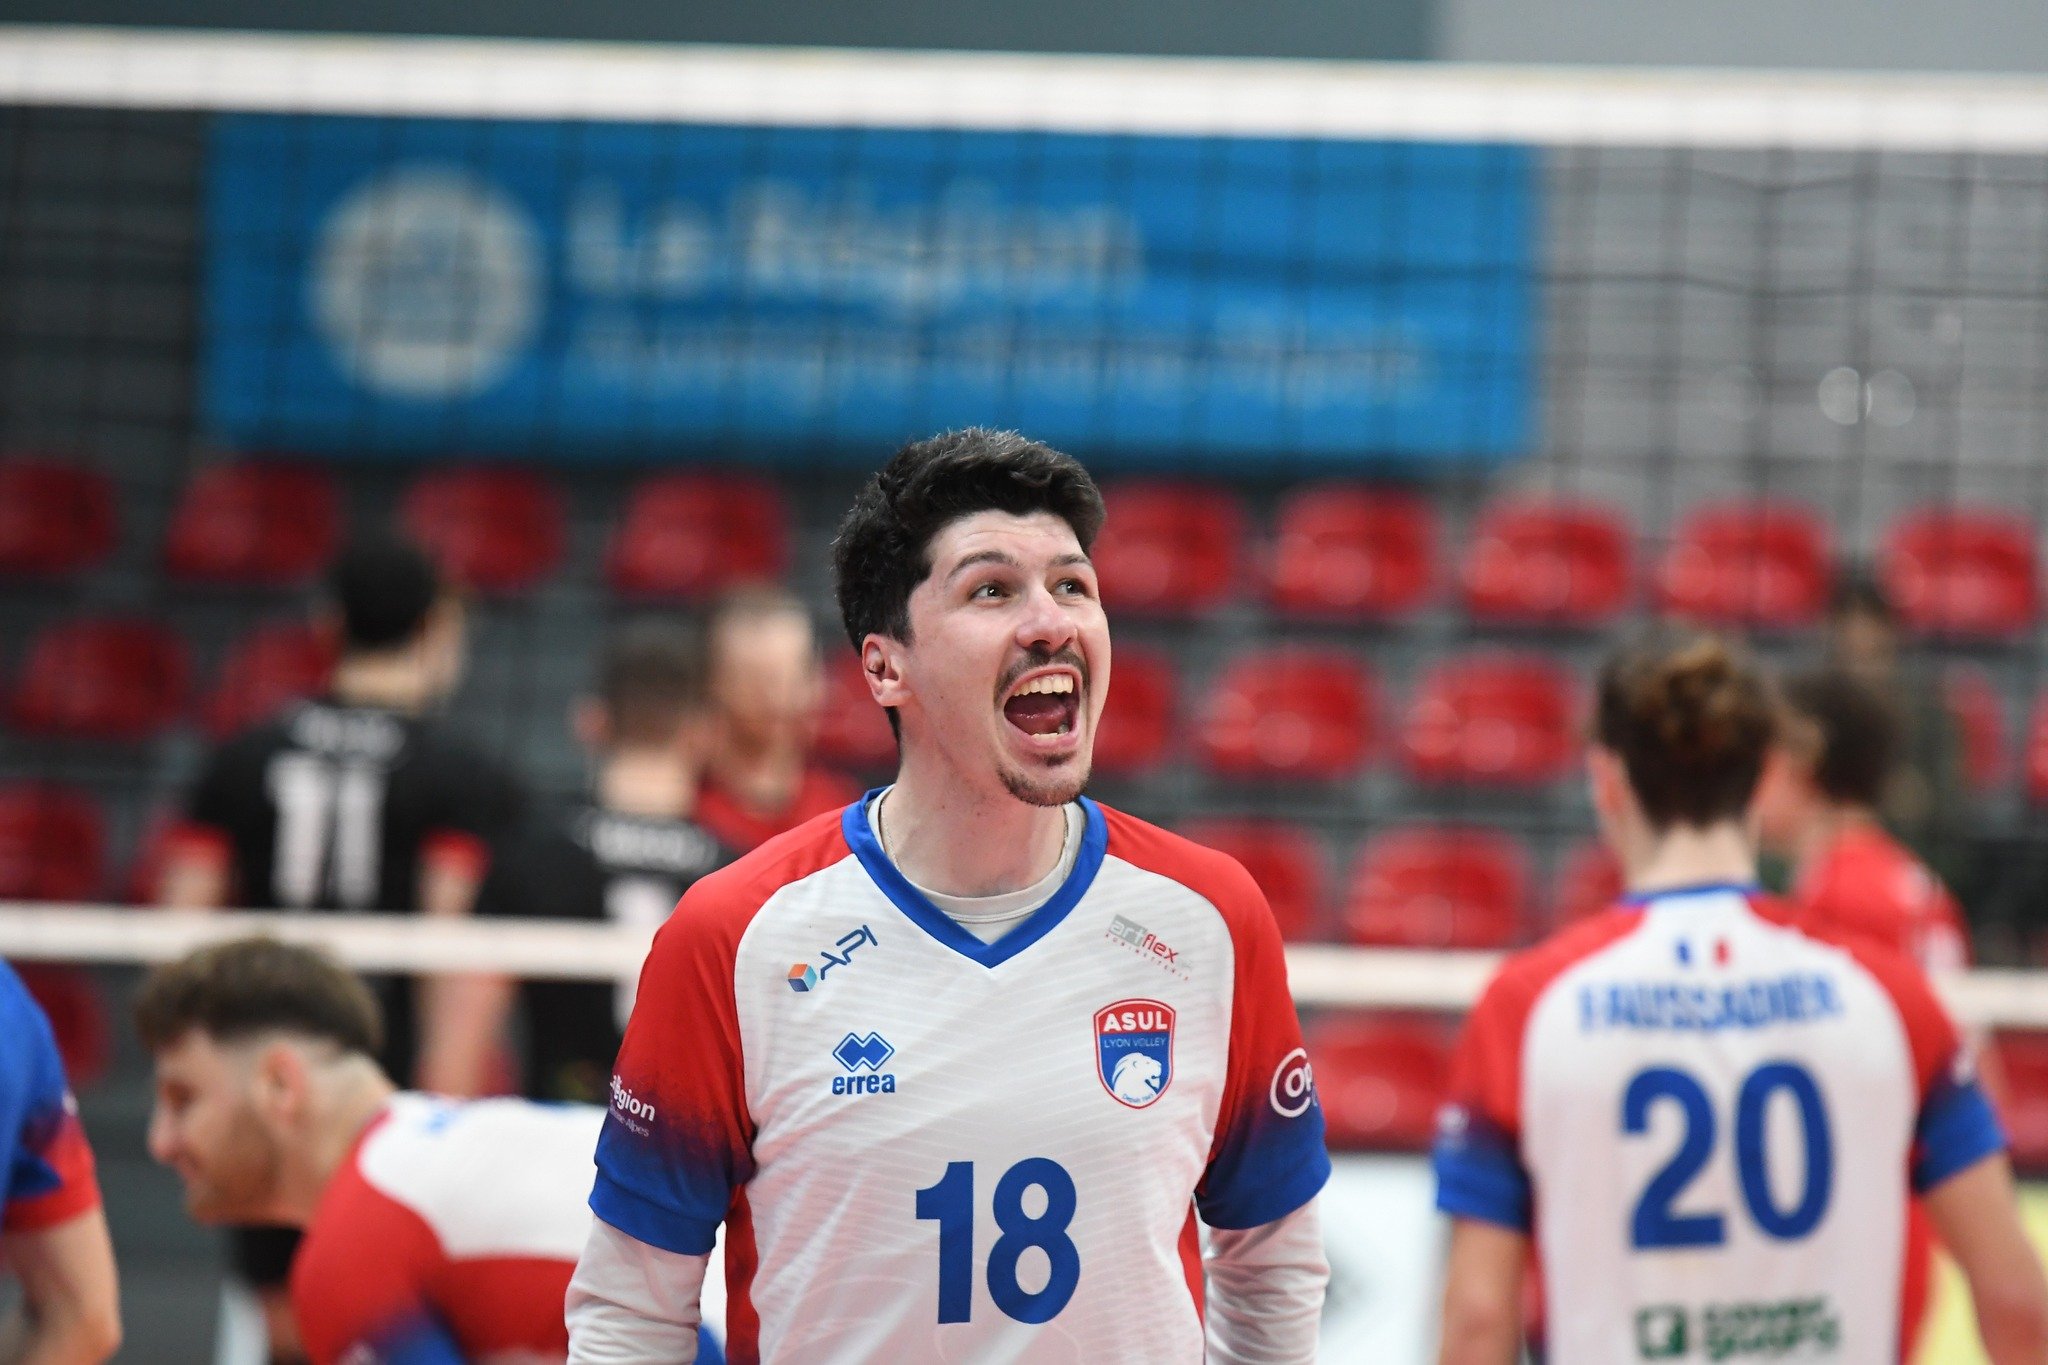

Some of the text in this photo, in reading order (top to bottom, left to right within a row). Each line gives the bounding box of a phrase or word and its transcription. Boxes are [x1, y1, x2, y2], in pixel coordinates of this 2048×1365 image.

[1103, 1010, 1169, 1032] ASUL
[1104, 1037, 1167, 1049] LYON VOLLEY
[1619, 1060, 1836, 1251] 20
[915, 1157, 1081, 1325] 18
